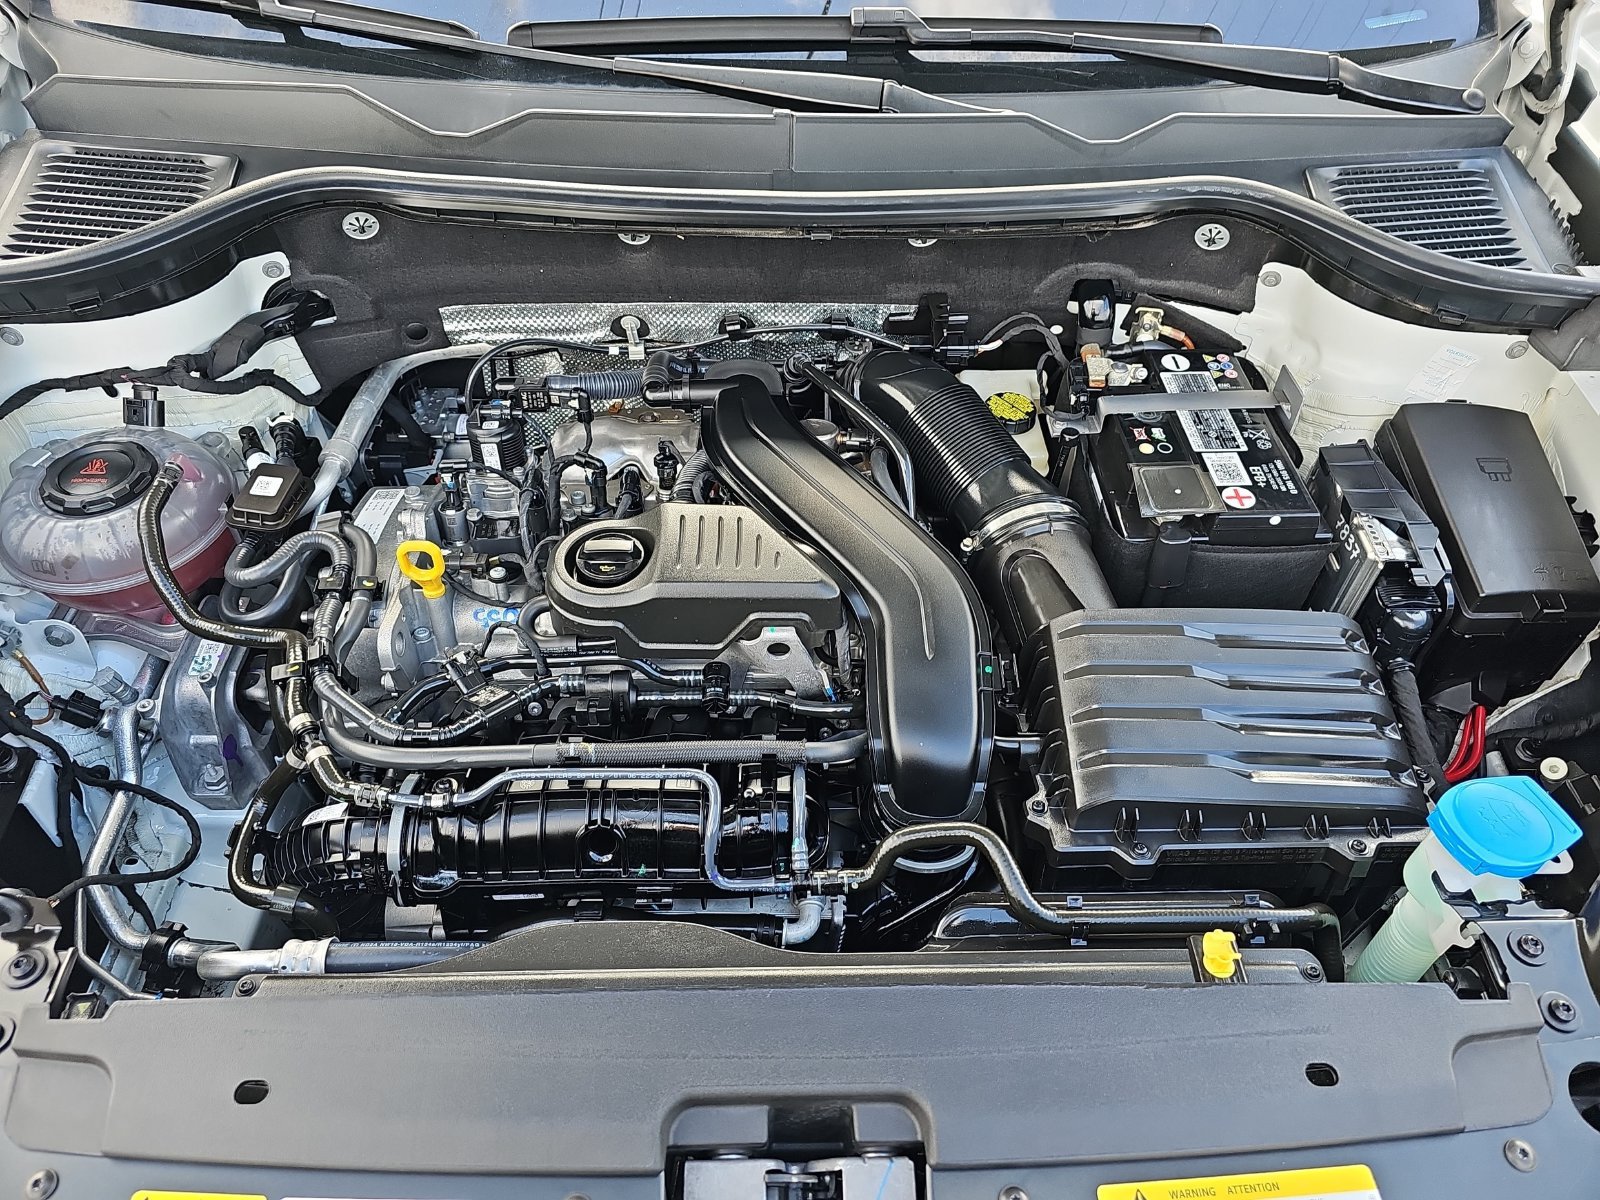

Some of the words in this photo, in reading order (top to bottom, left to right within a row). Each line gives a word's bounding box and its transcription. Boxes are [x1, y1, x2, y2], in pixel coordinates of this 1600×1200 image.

[1252, 465, 1266, 490] EFB+
[1336, 515, 1360, 560] 7837
[1168, 1186, 1216, 1199] WARNING
[1226, 1182, 1280, 1195] ATTENTION
